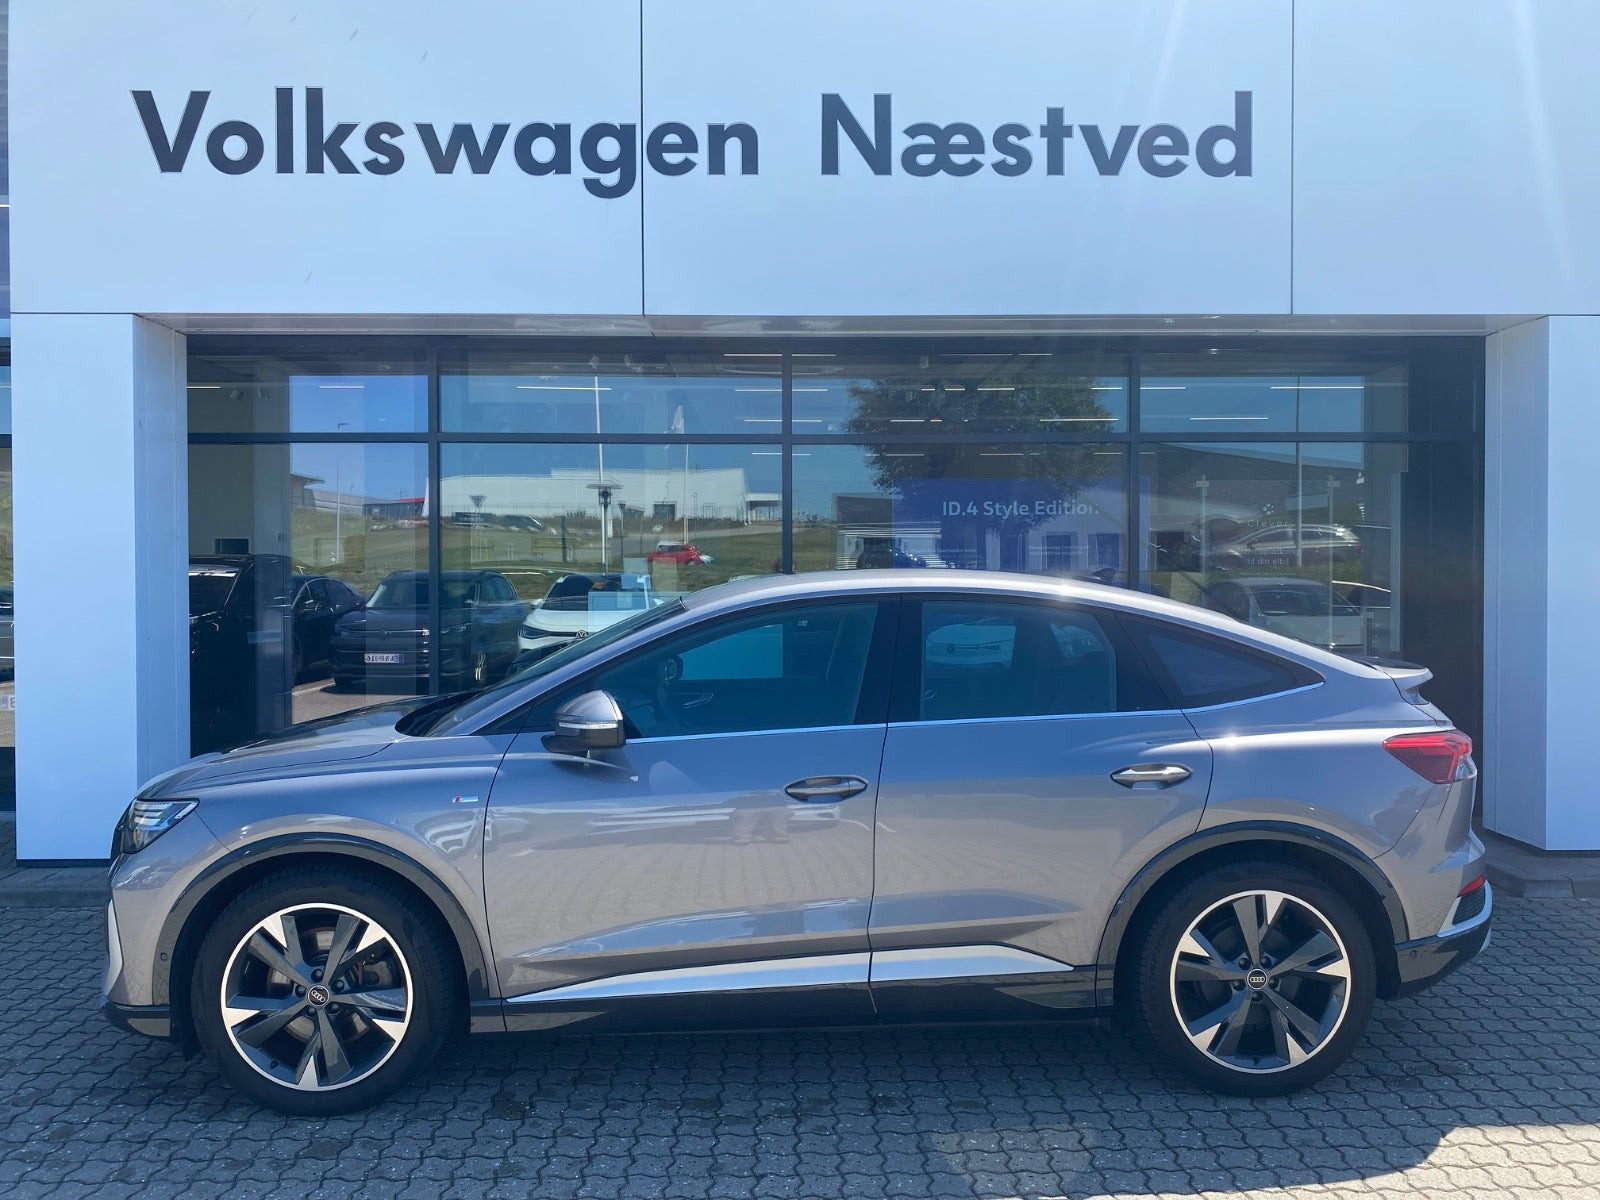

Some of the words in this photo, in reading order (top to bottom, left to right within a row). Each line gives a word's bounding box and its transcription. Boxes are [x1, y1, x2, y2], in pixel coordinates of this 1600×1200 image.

[131, 86, 758, 198] Volkswagen
[821, 90, 1252, 177] Næstved
[942, 501, 978, 516] ID.4
[983, 500, 1029, 519] Style
